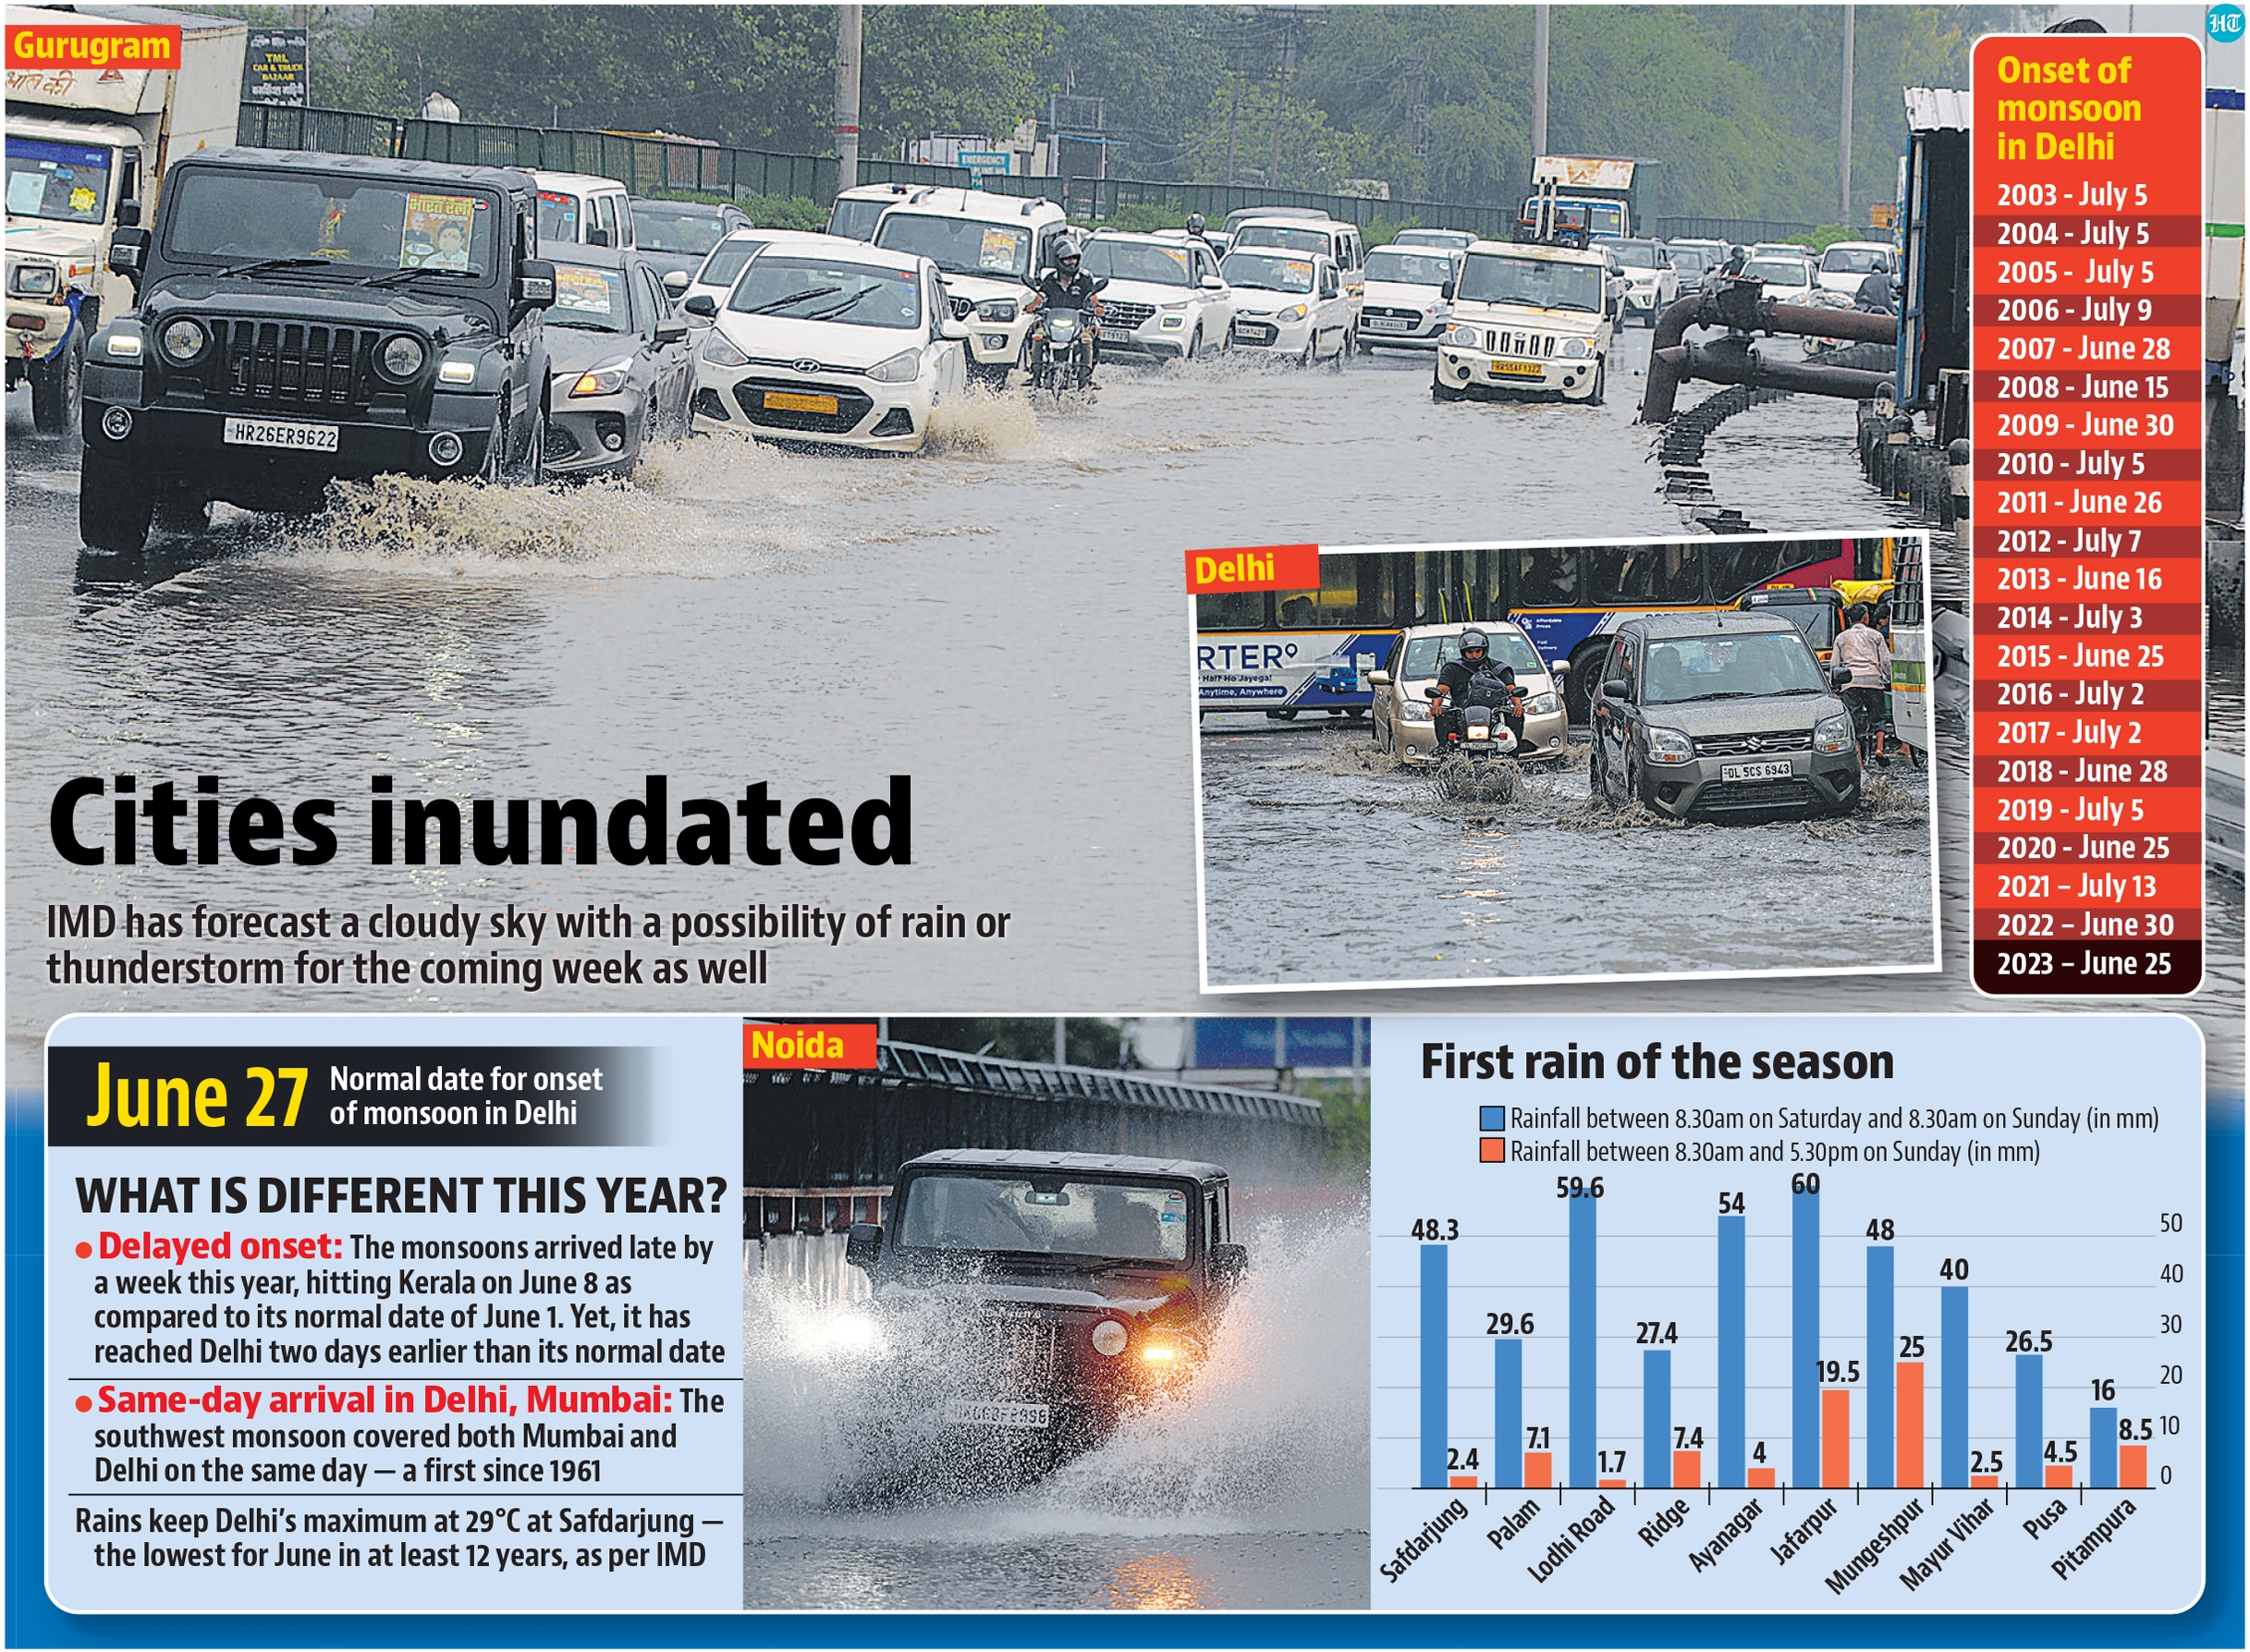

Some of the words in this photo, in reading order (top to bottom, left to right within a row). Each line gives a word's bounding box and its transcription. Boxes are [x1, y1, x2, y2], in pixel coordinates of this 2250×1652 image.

[235, 422, 337, 448] HR26ER9622
[1199, 688, 1238, 698] Anytime,
[1240, 688, 1284, 697] Anywhere
[1728, 767, 1741, 778] DL
[1743, 766, 1762, 777] 5CS
[1765, 764, 1790, 776] 6943
